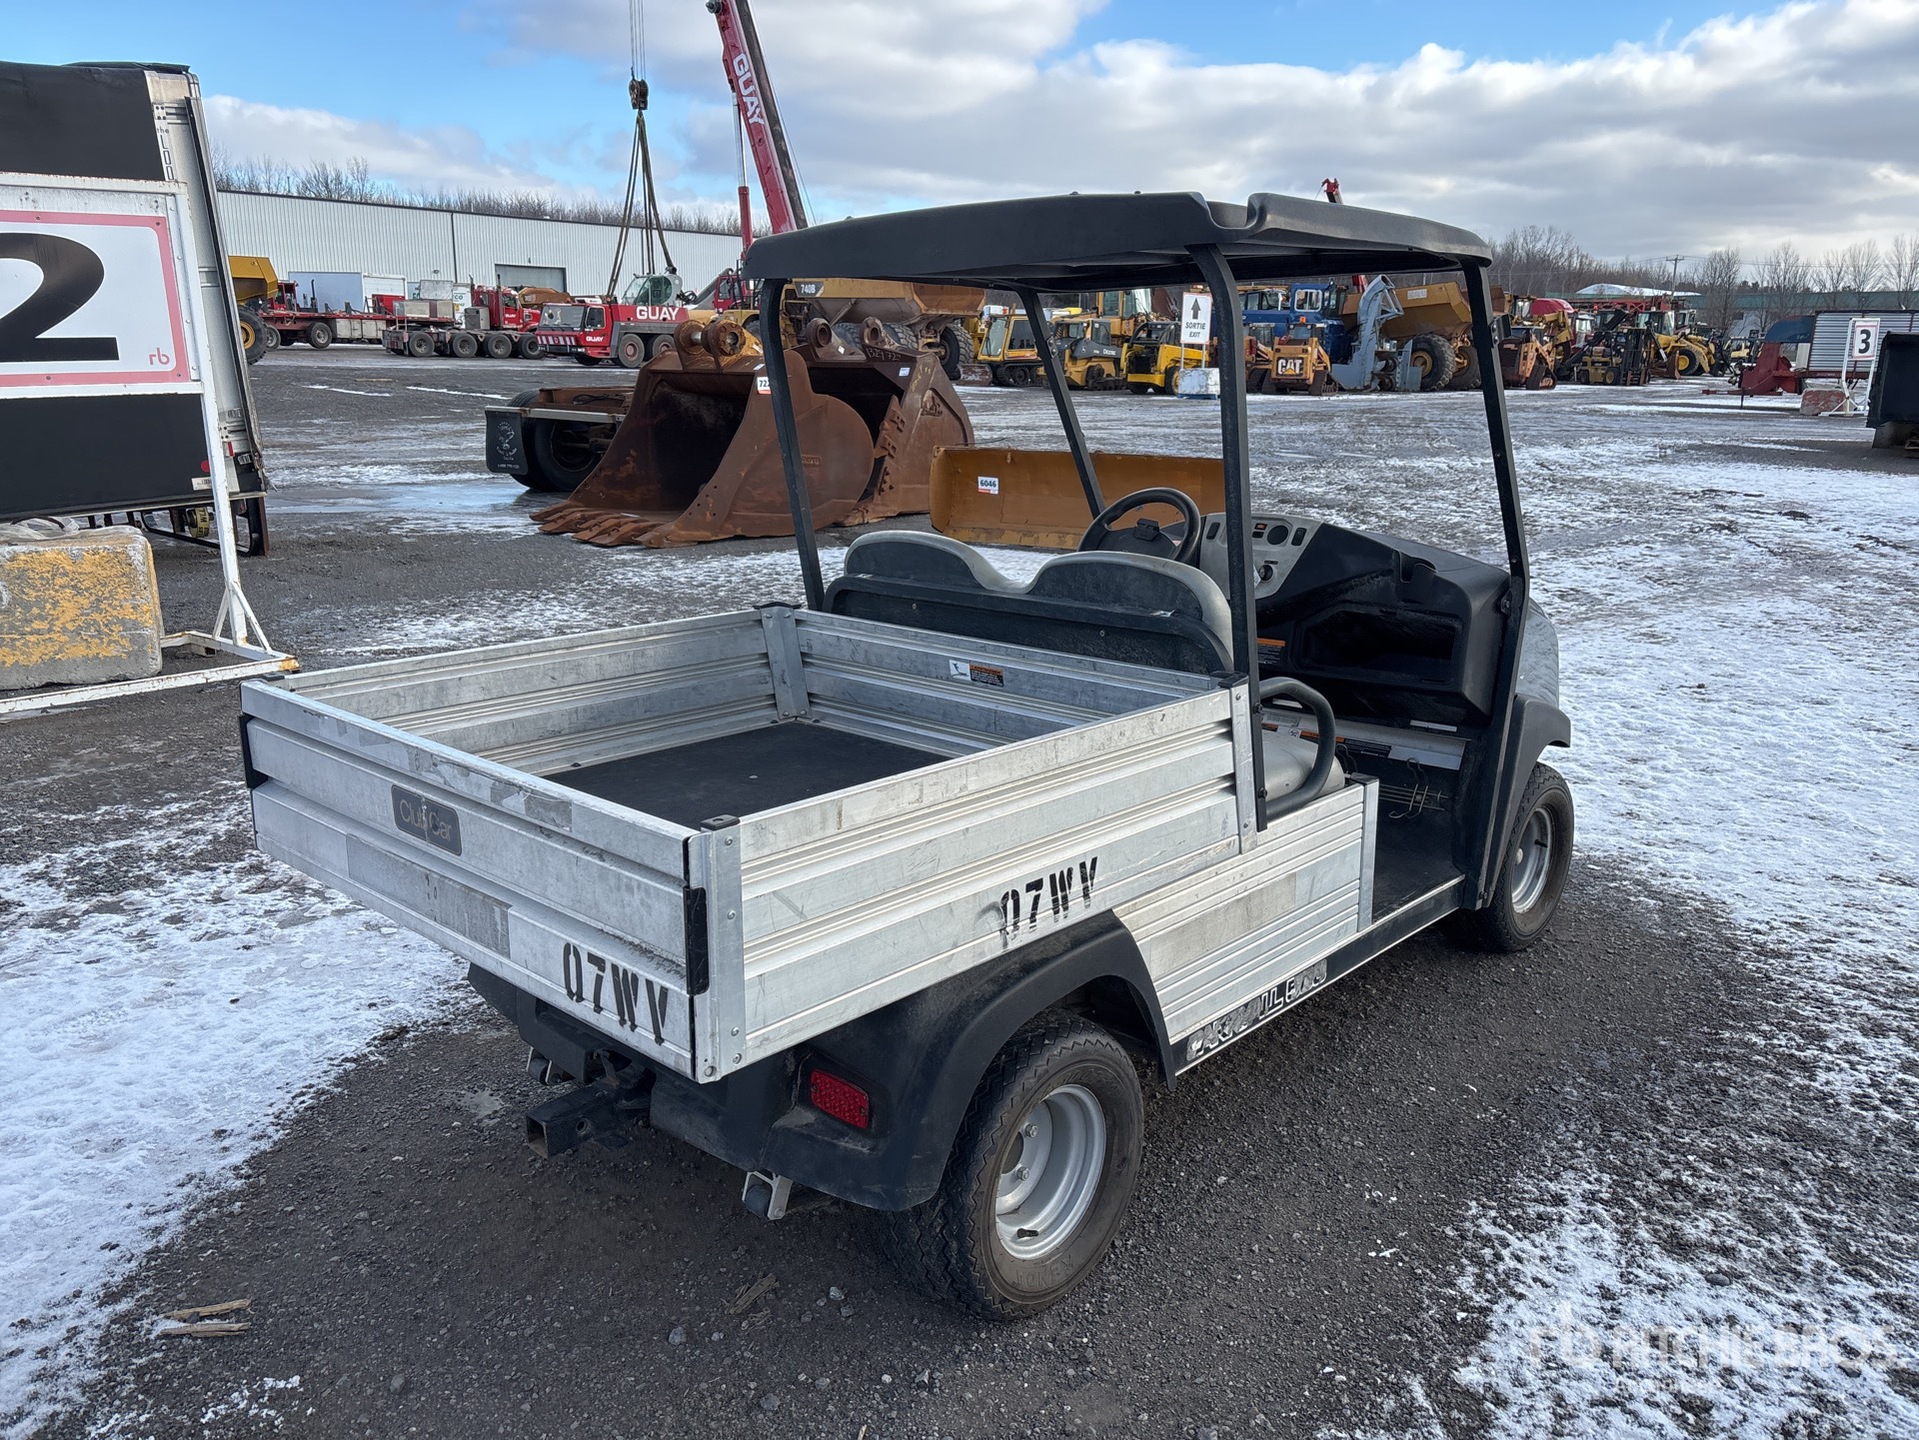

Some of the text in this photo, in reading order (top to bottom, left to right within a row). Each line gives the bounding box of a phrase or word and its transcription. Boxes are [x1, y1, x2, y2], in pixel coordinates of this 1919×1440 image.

[732, 53, 765, 125] GUAY
[0, 232, 120, 362] 2
[636, 305, 679, 321] GUAY
[1184, 321, 1207, 330] SORTIE
[1858, 328, 1871, 354] 3
[149, 347, 170, 366] rb
[1277, 358, 1303, 375] CAT
[980, 479, 997, 488] 6046
[428, 811, 452, 841] Car
[563, 942, 669, 1046] 07WV
